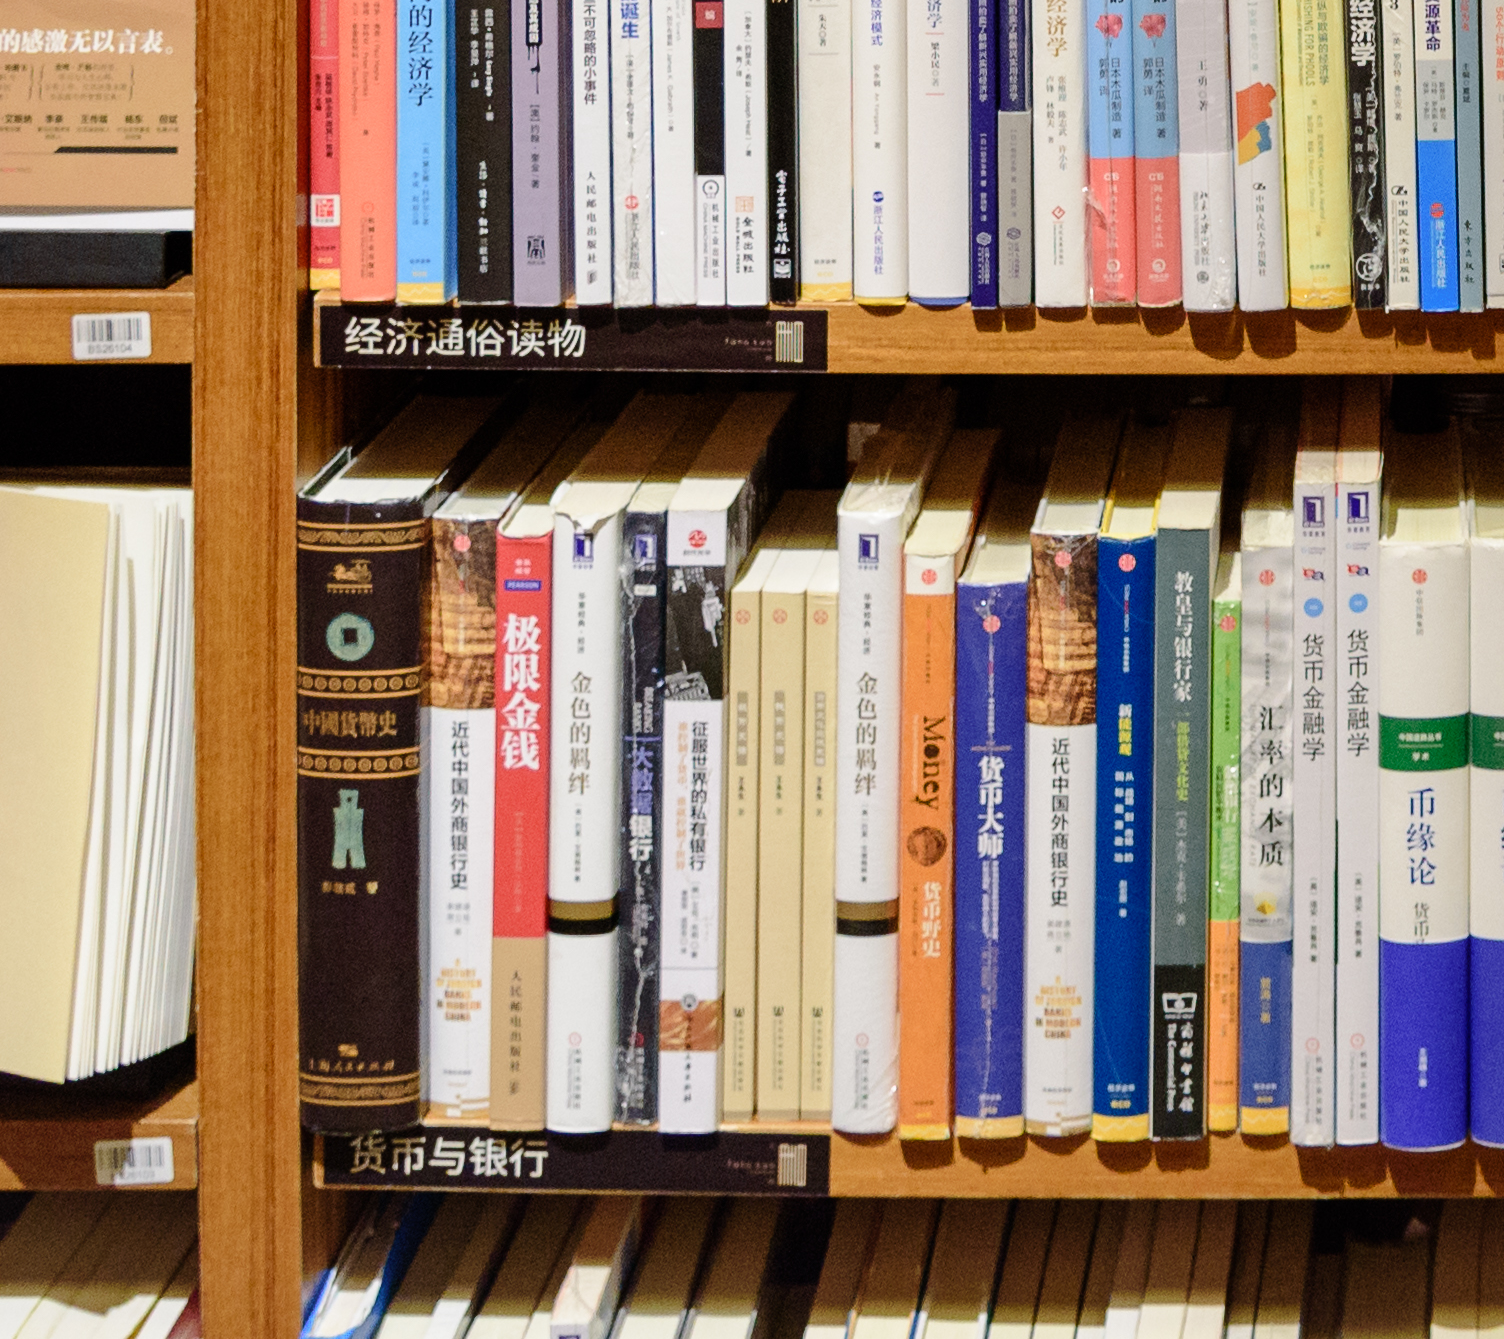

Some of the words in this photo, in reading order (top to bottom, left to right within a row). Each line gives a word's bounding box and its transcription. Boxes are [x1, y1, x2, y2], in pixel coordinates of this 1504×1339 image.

[344, 319, 587, 358] 经济通俗读物
[501, 613, 540, 770] 极限金钱
[1302, 632, 1325, 762] 货币金融学
[914, 716, 945, 811] Money
[1407, 787, 1435, 887] 币缘论
